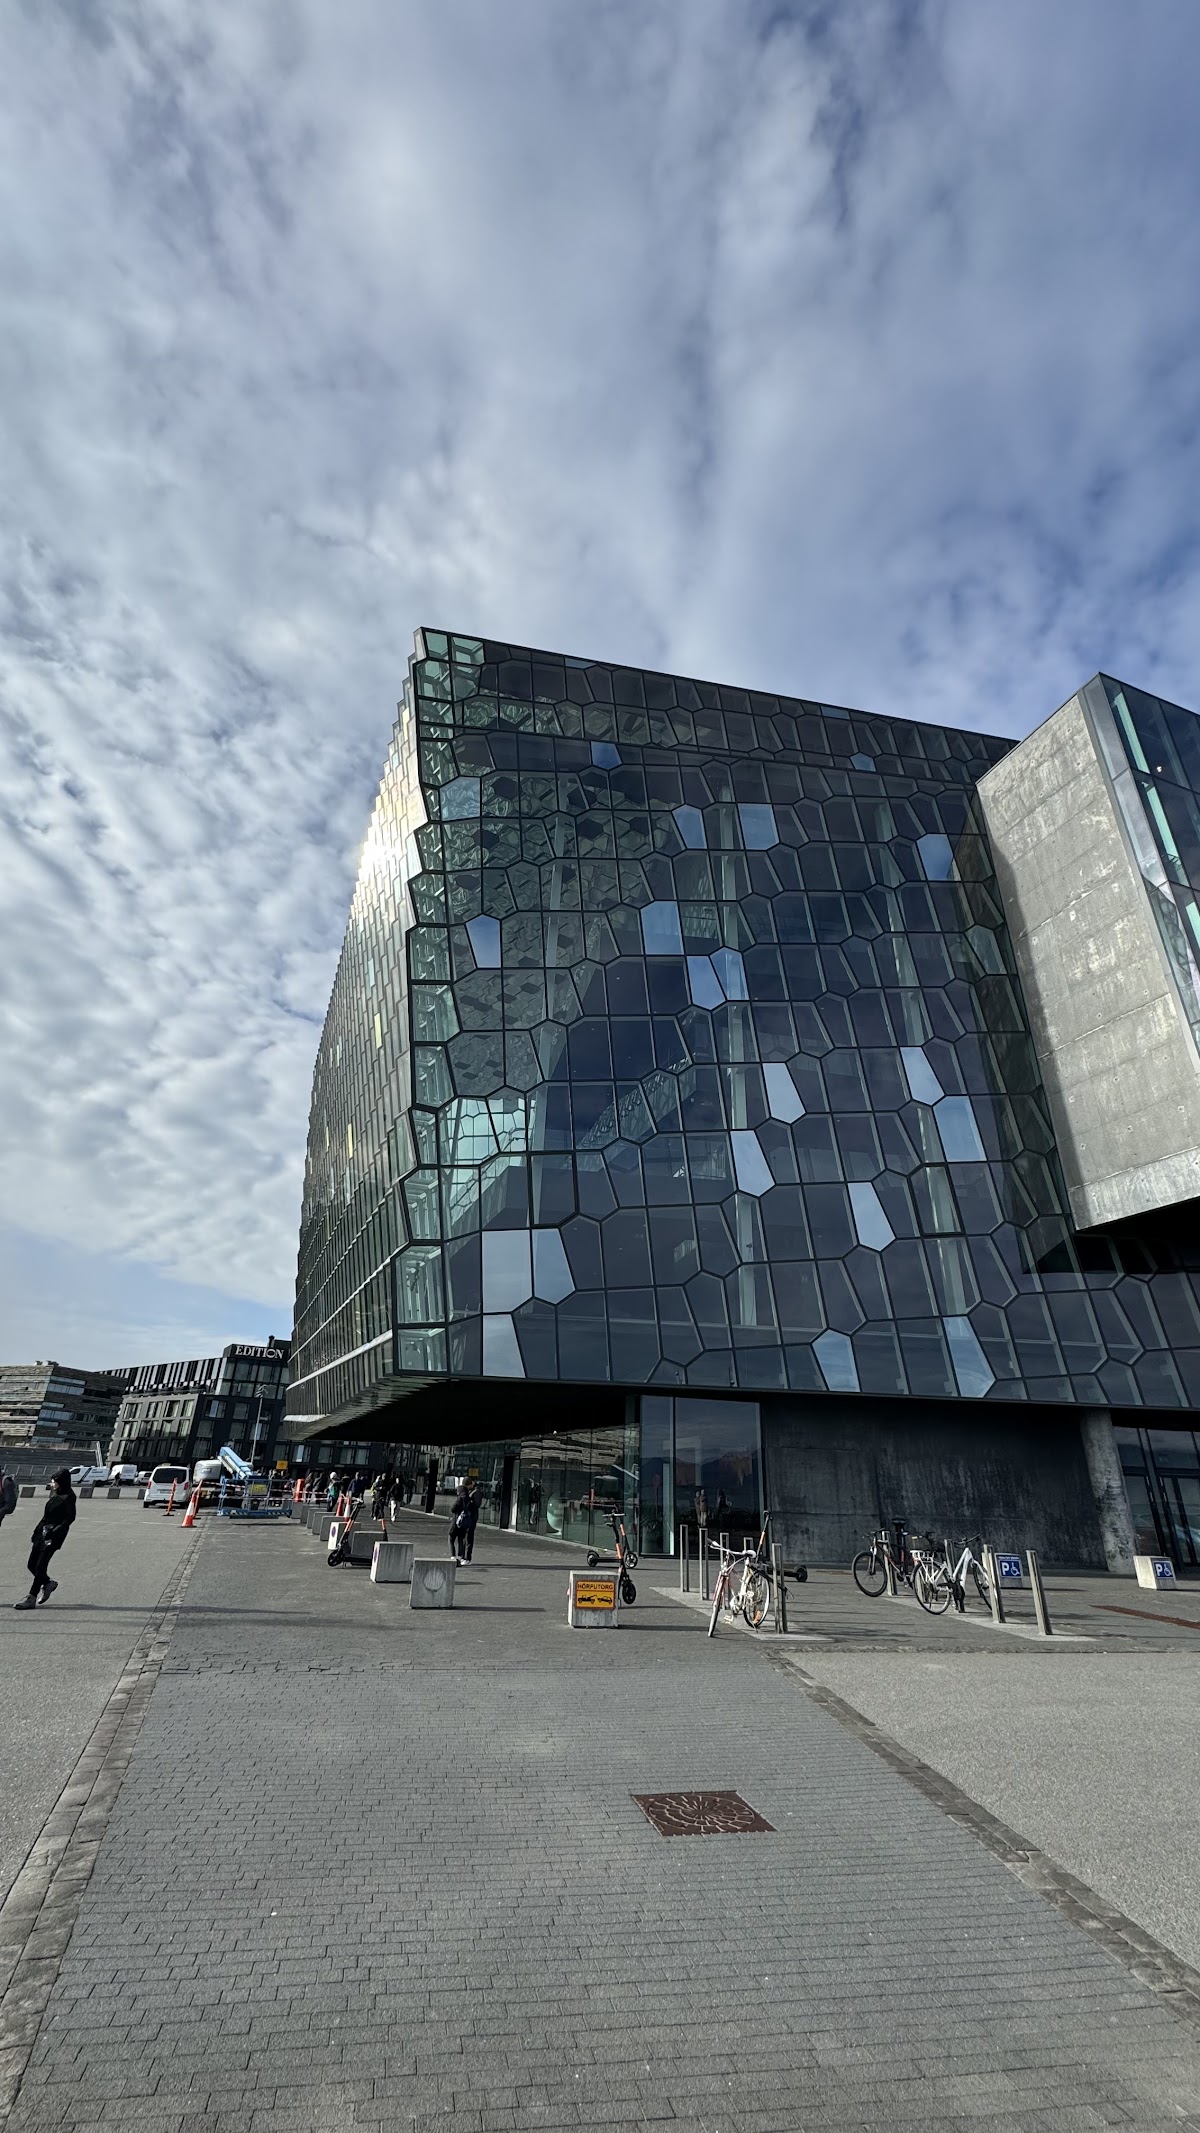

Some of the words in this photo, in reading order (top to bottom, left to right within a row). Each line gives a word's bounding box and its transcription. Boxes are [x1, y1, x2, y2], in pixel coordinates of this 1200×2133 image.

[235, 1345, 284, 1359] EDITION
[1001, 1562, 1009, 1575] P
[1155, 1563, 1162, 1576] P
